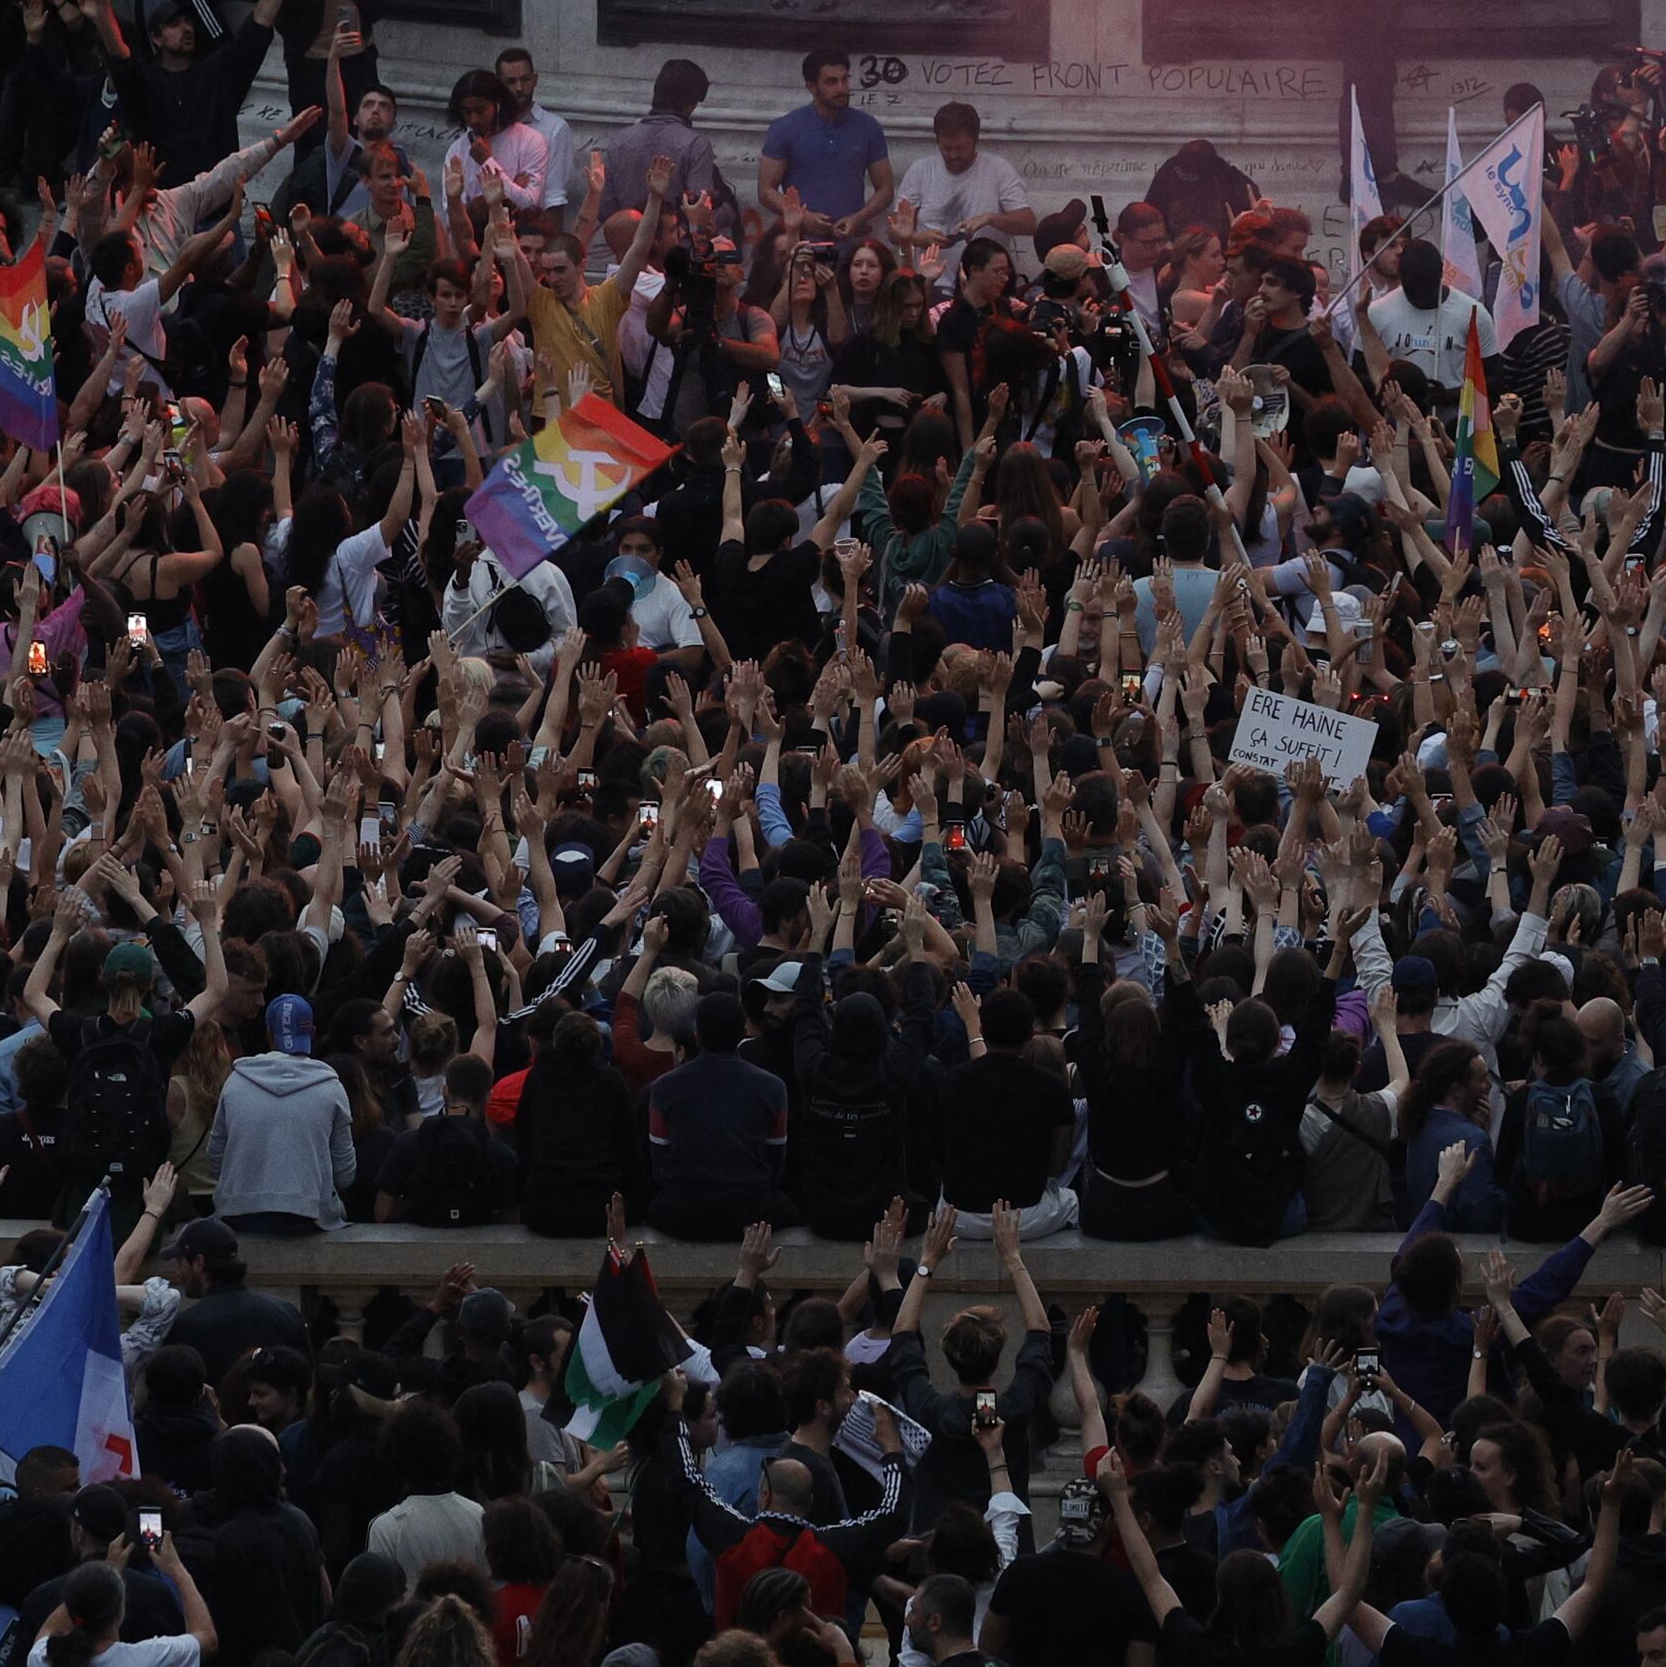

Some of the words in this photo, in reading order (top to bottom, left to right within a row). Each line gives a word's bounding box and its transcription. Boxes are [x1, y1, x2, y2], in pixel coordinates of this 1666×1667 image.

[921, 61, 1014, 85] VOTEZ
[1032, 61, 1129, 91] FRONT
[1148, 64, 1328, 99] POPULAIRE
[1251, 689, 1285, 720] ÈRE
[1249, 727, 1268, 748] ÇA
[1232, 747, 1279, 769] CONSTAT
